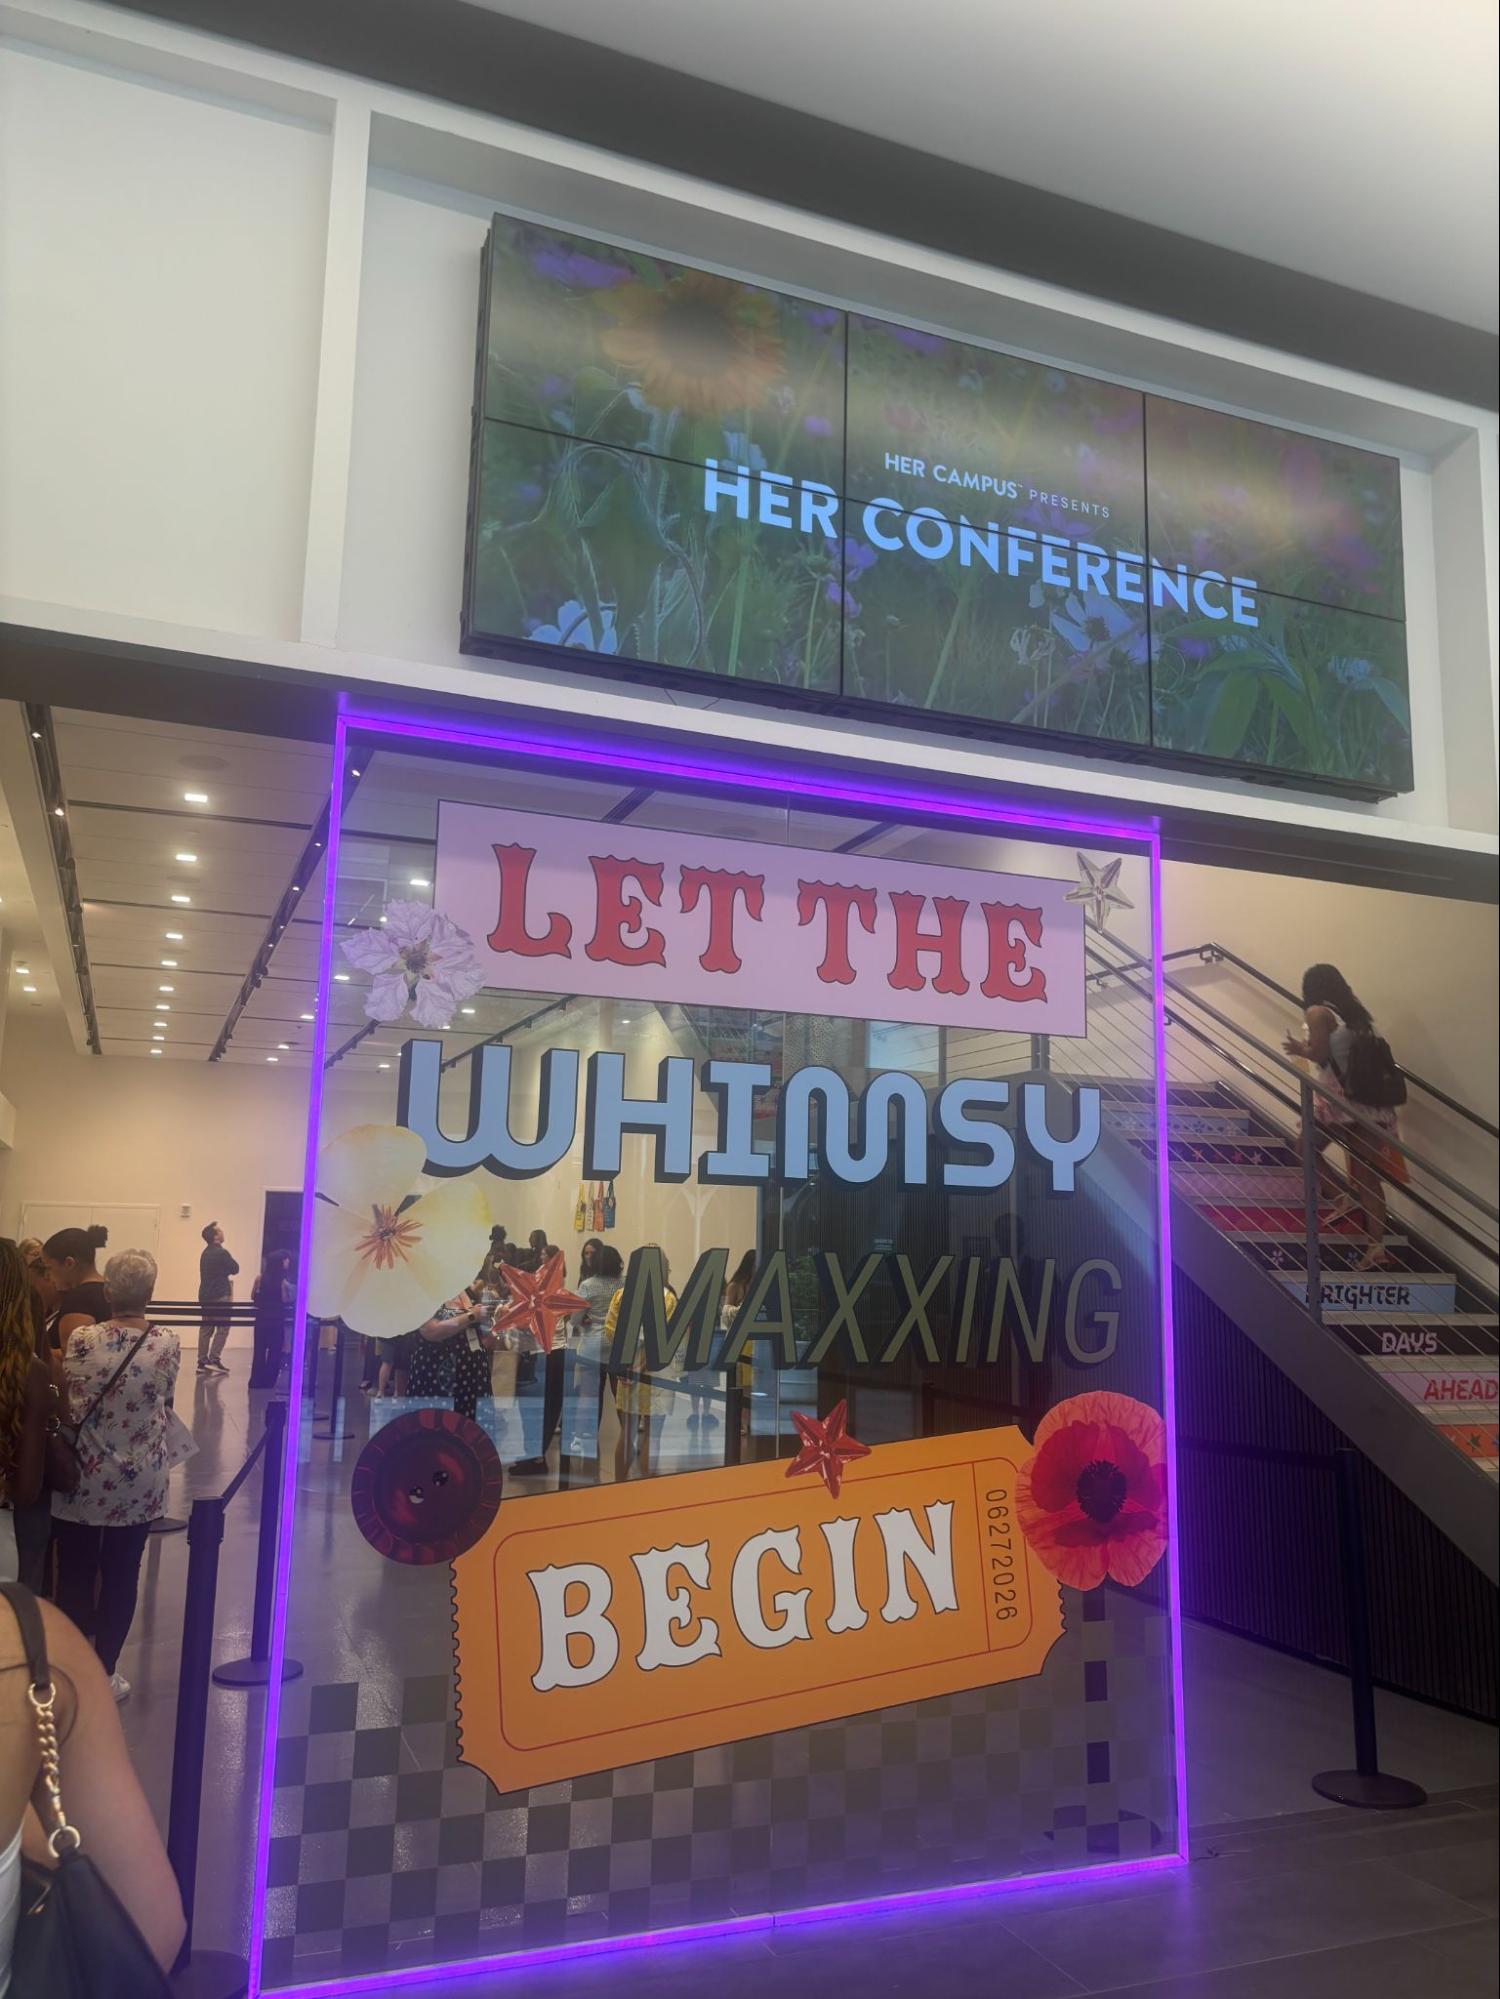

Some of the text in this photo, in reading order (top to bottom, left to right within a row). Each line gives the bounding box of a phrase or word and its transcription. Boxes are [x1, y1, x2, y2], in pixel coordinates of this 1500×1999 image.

[703, 457, 1259, 628] HER CONFERENCE
[885, 452, 926, 478] HER
[1029, 488, 1110, 519] PRESENTS
[486, 842, 1049, 1004] LET THE
[400, 1039, 1102, 1193] WHIMSY
[609, 1246, 1123, 1370] MAXXING
[1305, 1285, 1410, 1310] RIGHTER
[1381, 1331, 1438, 1353] DAYS
[1424, 1379, 1498, 1401] AHEAD
[525, 1499, 960, 1693] BEGIN
[986, 1489, 1018, 1621] 06272026
